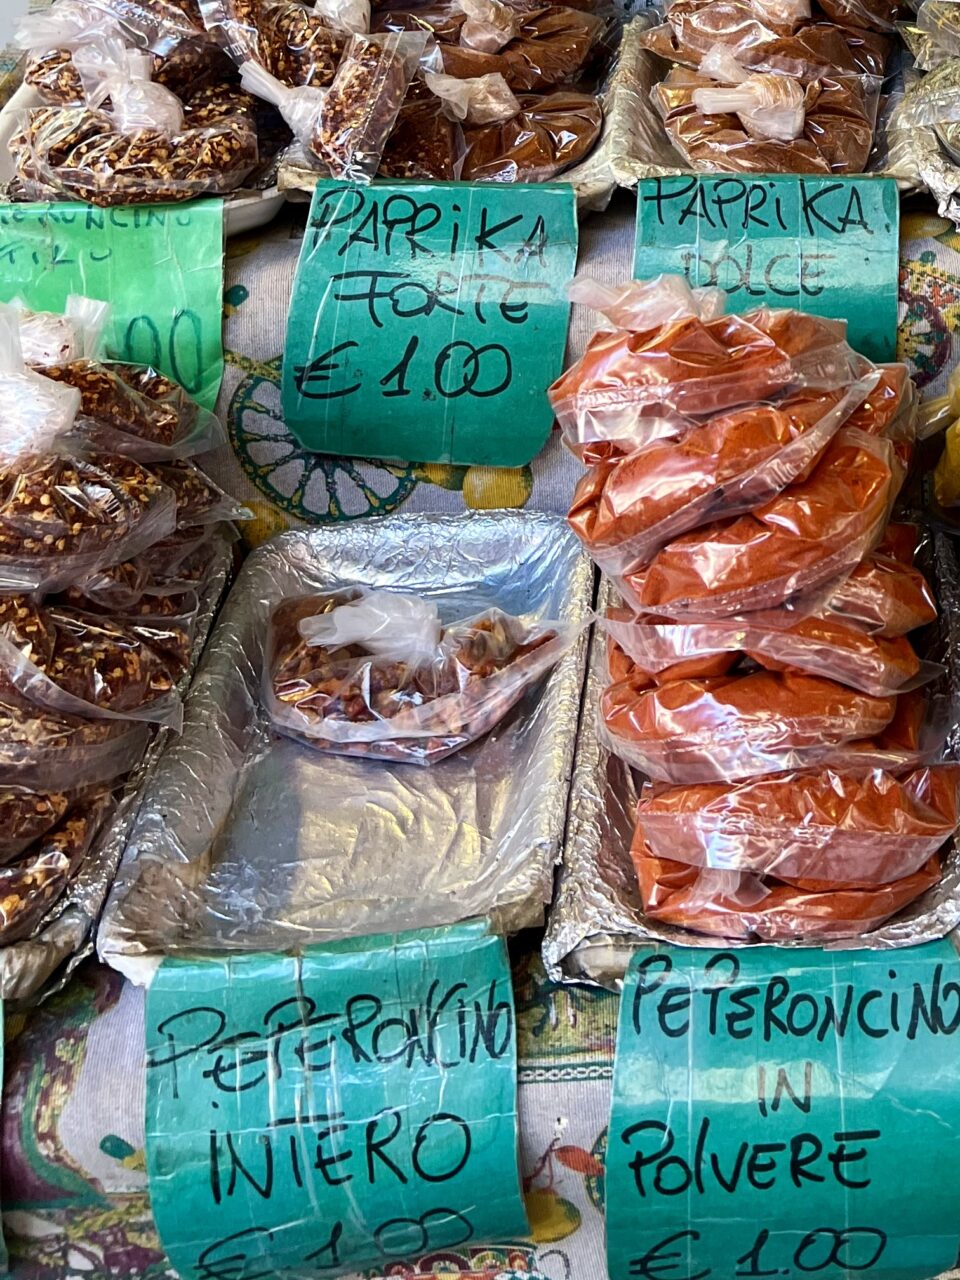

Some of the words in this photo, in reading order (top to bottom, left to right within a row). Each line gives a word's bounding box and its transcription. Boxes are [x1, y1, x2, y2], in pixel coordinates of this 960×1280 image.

[311, 186, 548, 268] PAPRIKA
[643, 176, 874, 236] PAPRIKA
[331, 270, 550, 328] FORTE
[680, 244, 836, 297] DOLCE
[294, 340, 363, 400] €
[379, 335, 512, 400] 1.00
[757, 1061, 812, 1118] IN
[208, 1100, 472, 1205] INTERO
[620, 1116, 881, 1198] POLVERE
[628, 1229, 712, 1280] €
[735, 1226, 888, 1277] 1.00
